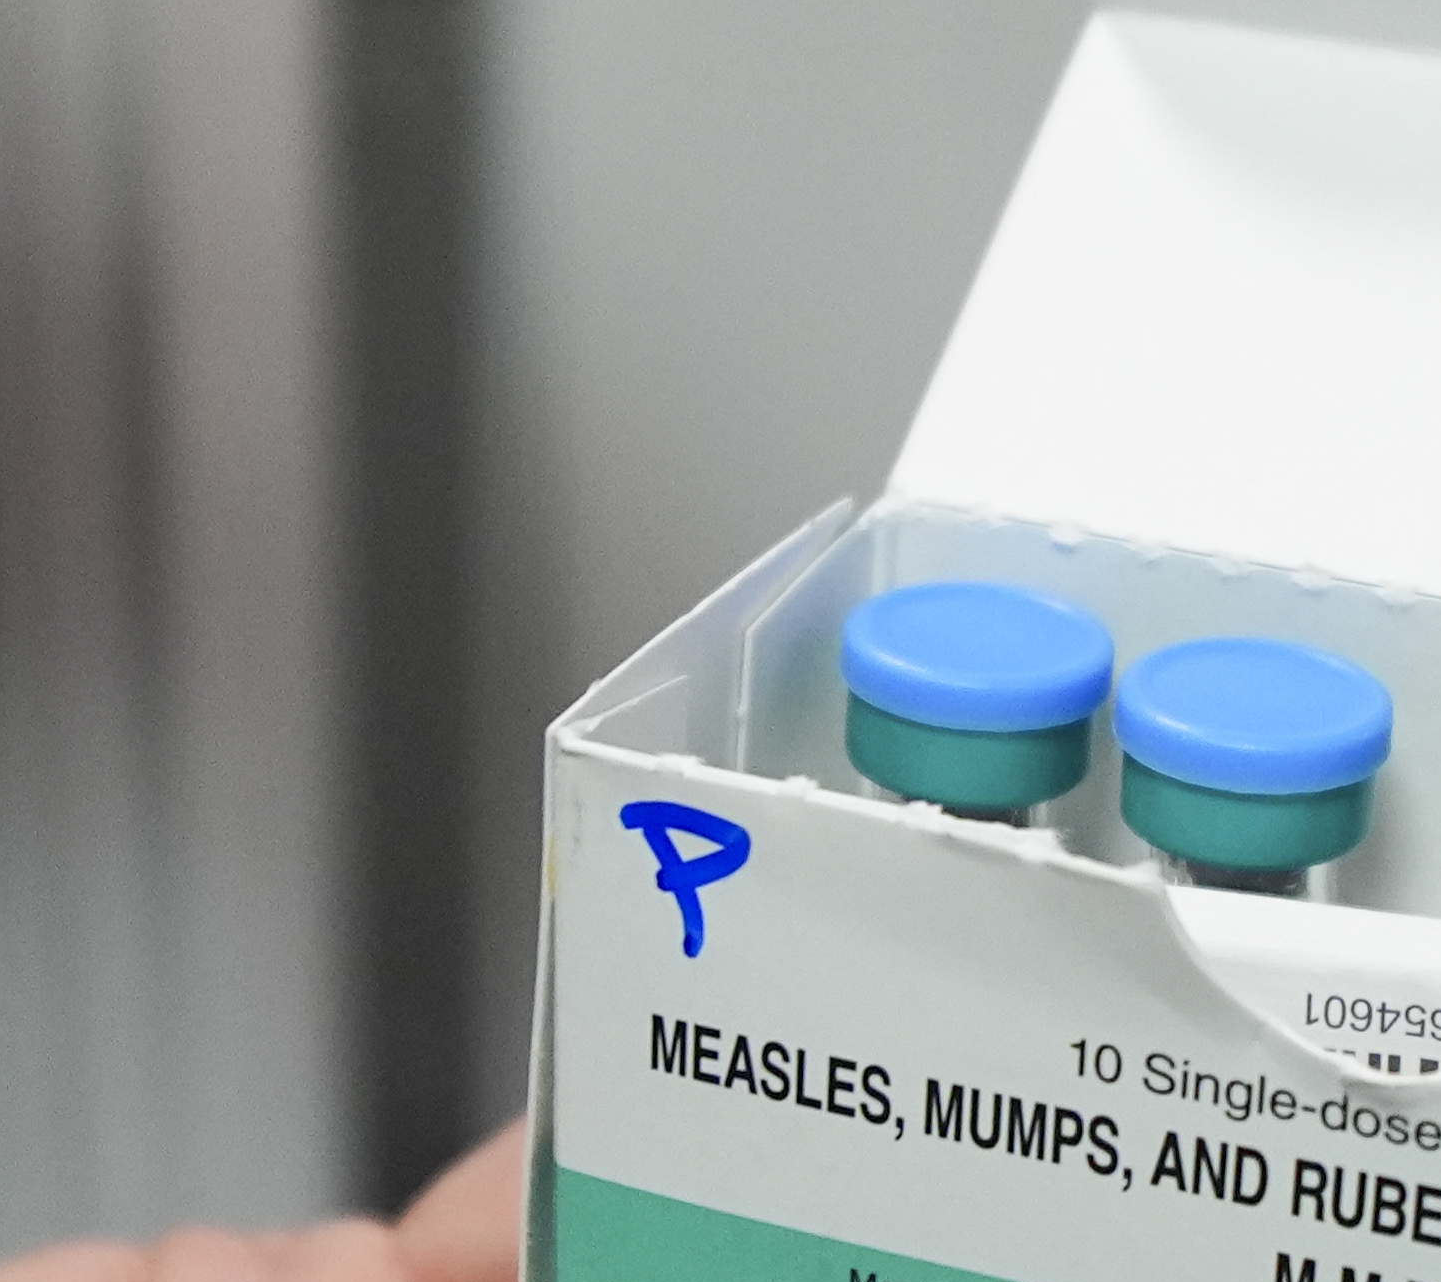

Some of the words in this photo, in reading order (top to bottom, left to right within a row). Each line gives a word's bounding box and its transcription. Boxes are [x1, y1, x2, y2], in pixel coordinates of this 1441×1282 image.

[620, 798, 752, 959] P
[650, 1013, 905, 1141] MEASLES,
[924, 1077, 1133, 1193] MUMPS,
[1150, 1130, 1270, 1208] AND
[1070, 1038, 1122, 1085] 10
